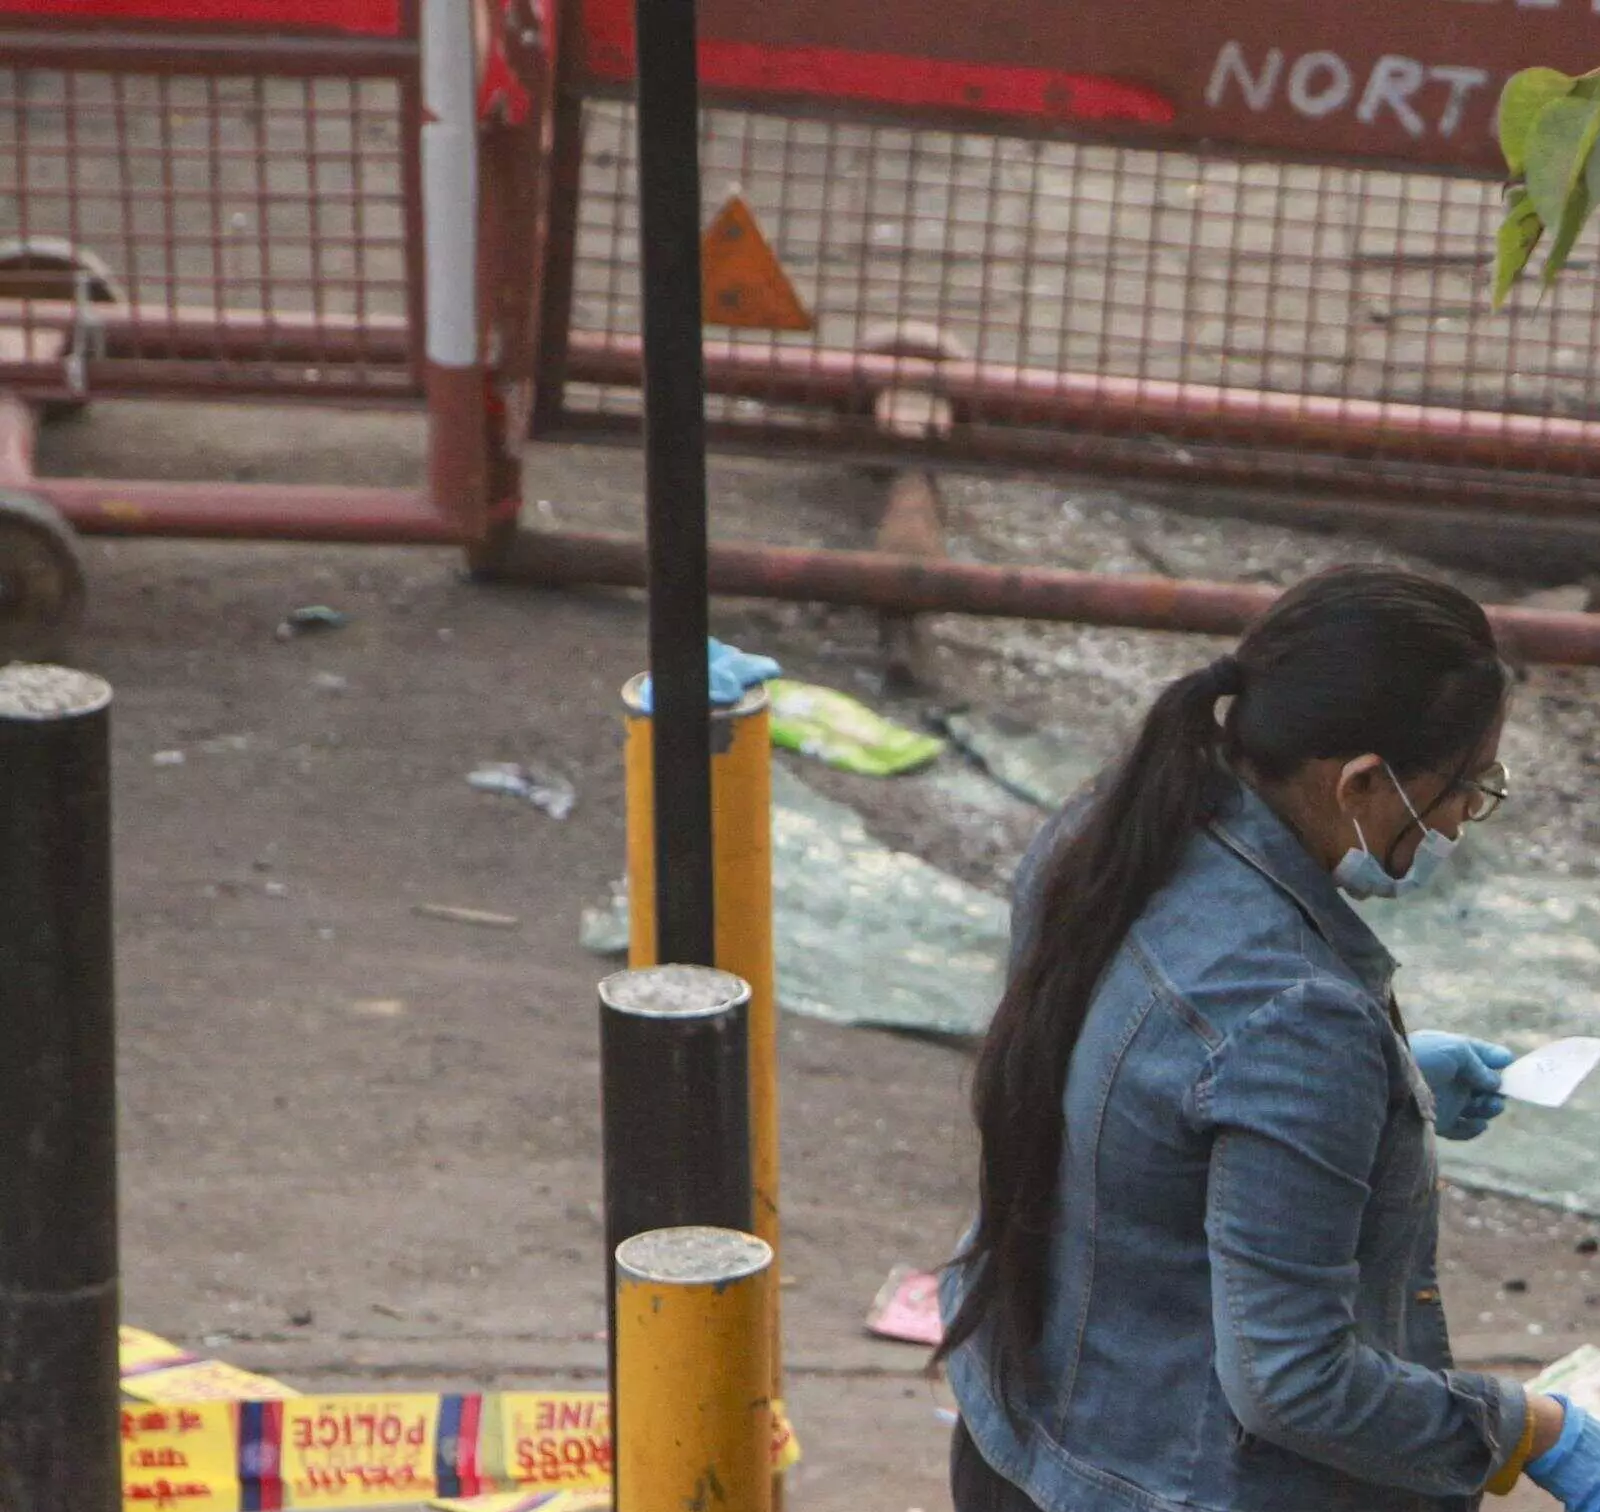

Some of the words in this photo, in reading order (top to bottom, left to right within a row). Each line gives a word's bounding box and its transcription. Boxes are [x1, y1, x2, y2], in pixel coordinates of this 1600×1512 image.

[1203, 39, 1502, 141] NORT
[291, 1413, 428, 1449] POLICE
[535, 1401, 611, 1431] INE
